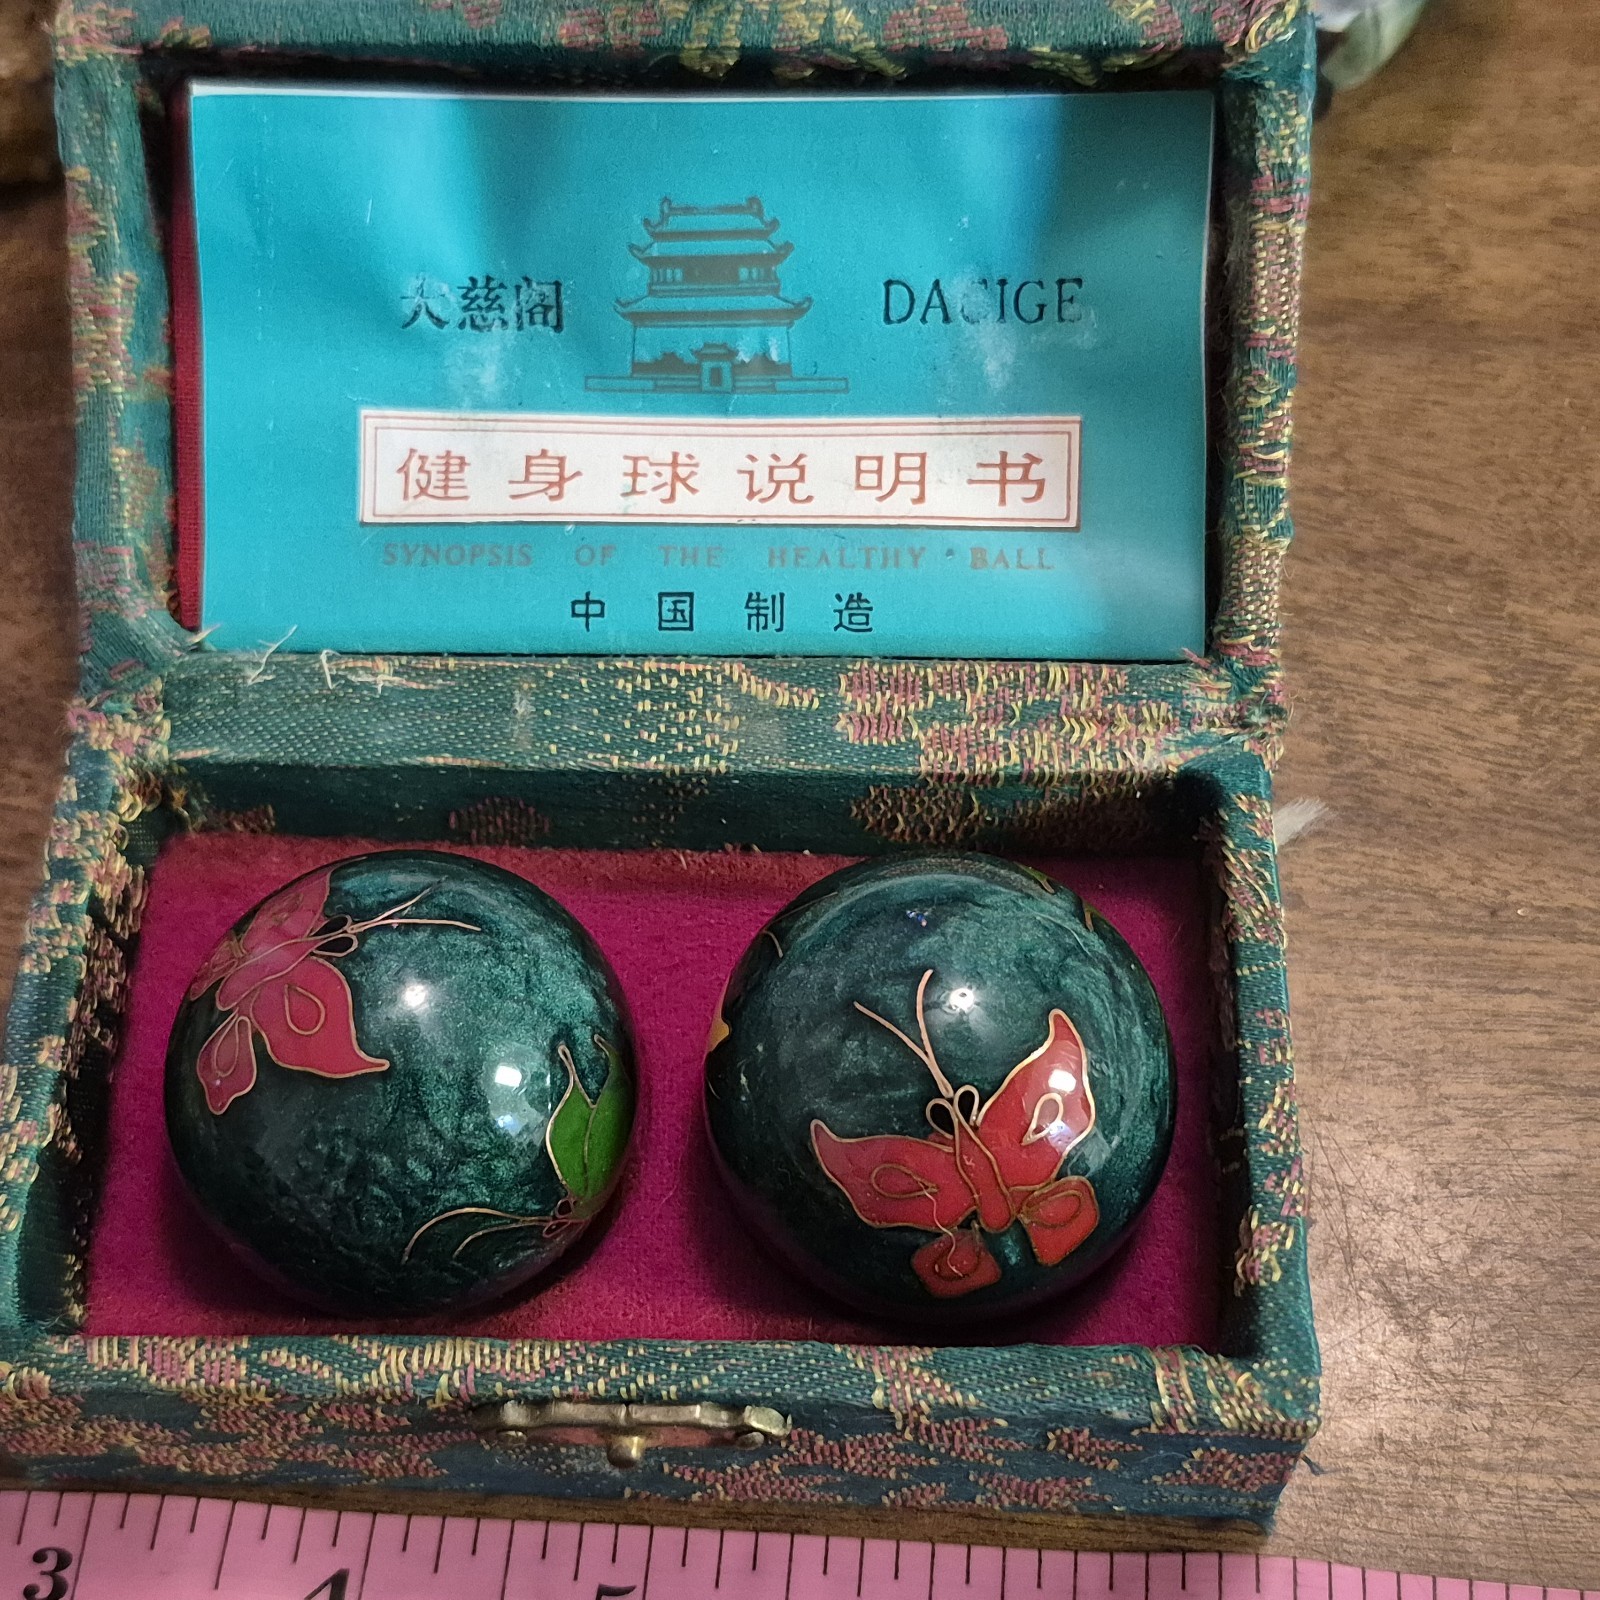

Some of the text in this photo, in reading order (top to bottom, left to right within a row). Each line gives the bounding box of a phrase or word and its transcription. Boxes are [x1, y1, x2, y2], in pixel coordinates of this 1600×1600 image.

[400, 273, 563, 333] 大慈阁
[397, 448, 1046, 506] 健身球说明书
[383, 543, 1055, 570] SYNOPSIS OF THE HEALTHY BALL
[571, 591, 873, 632] 中国制造
[23, 1546, 73, 1600] 3
